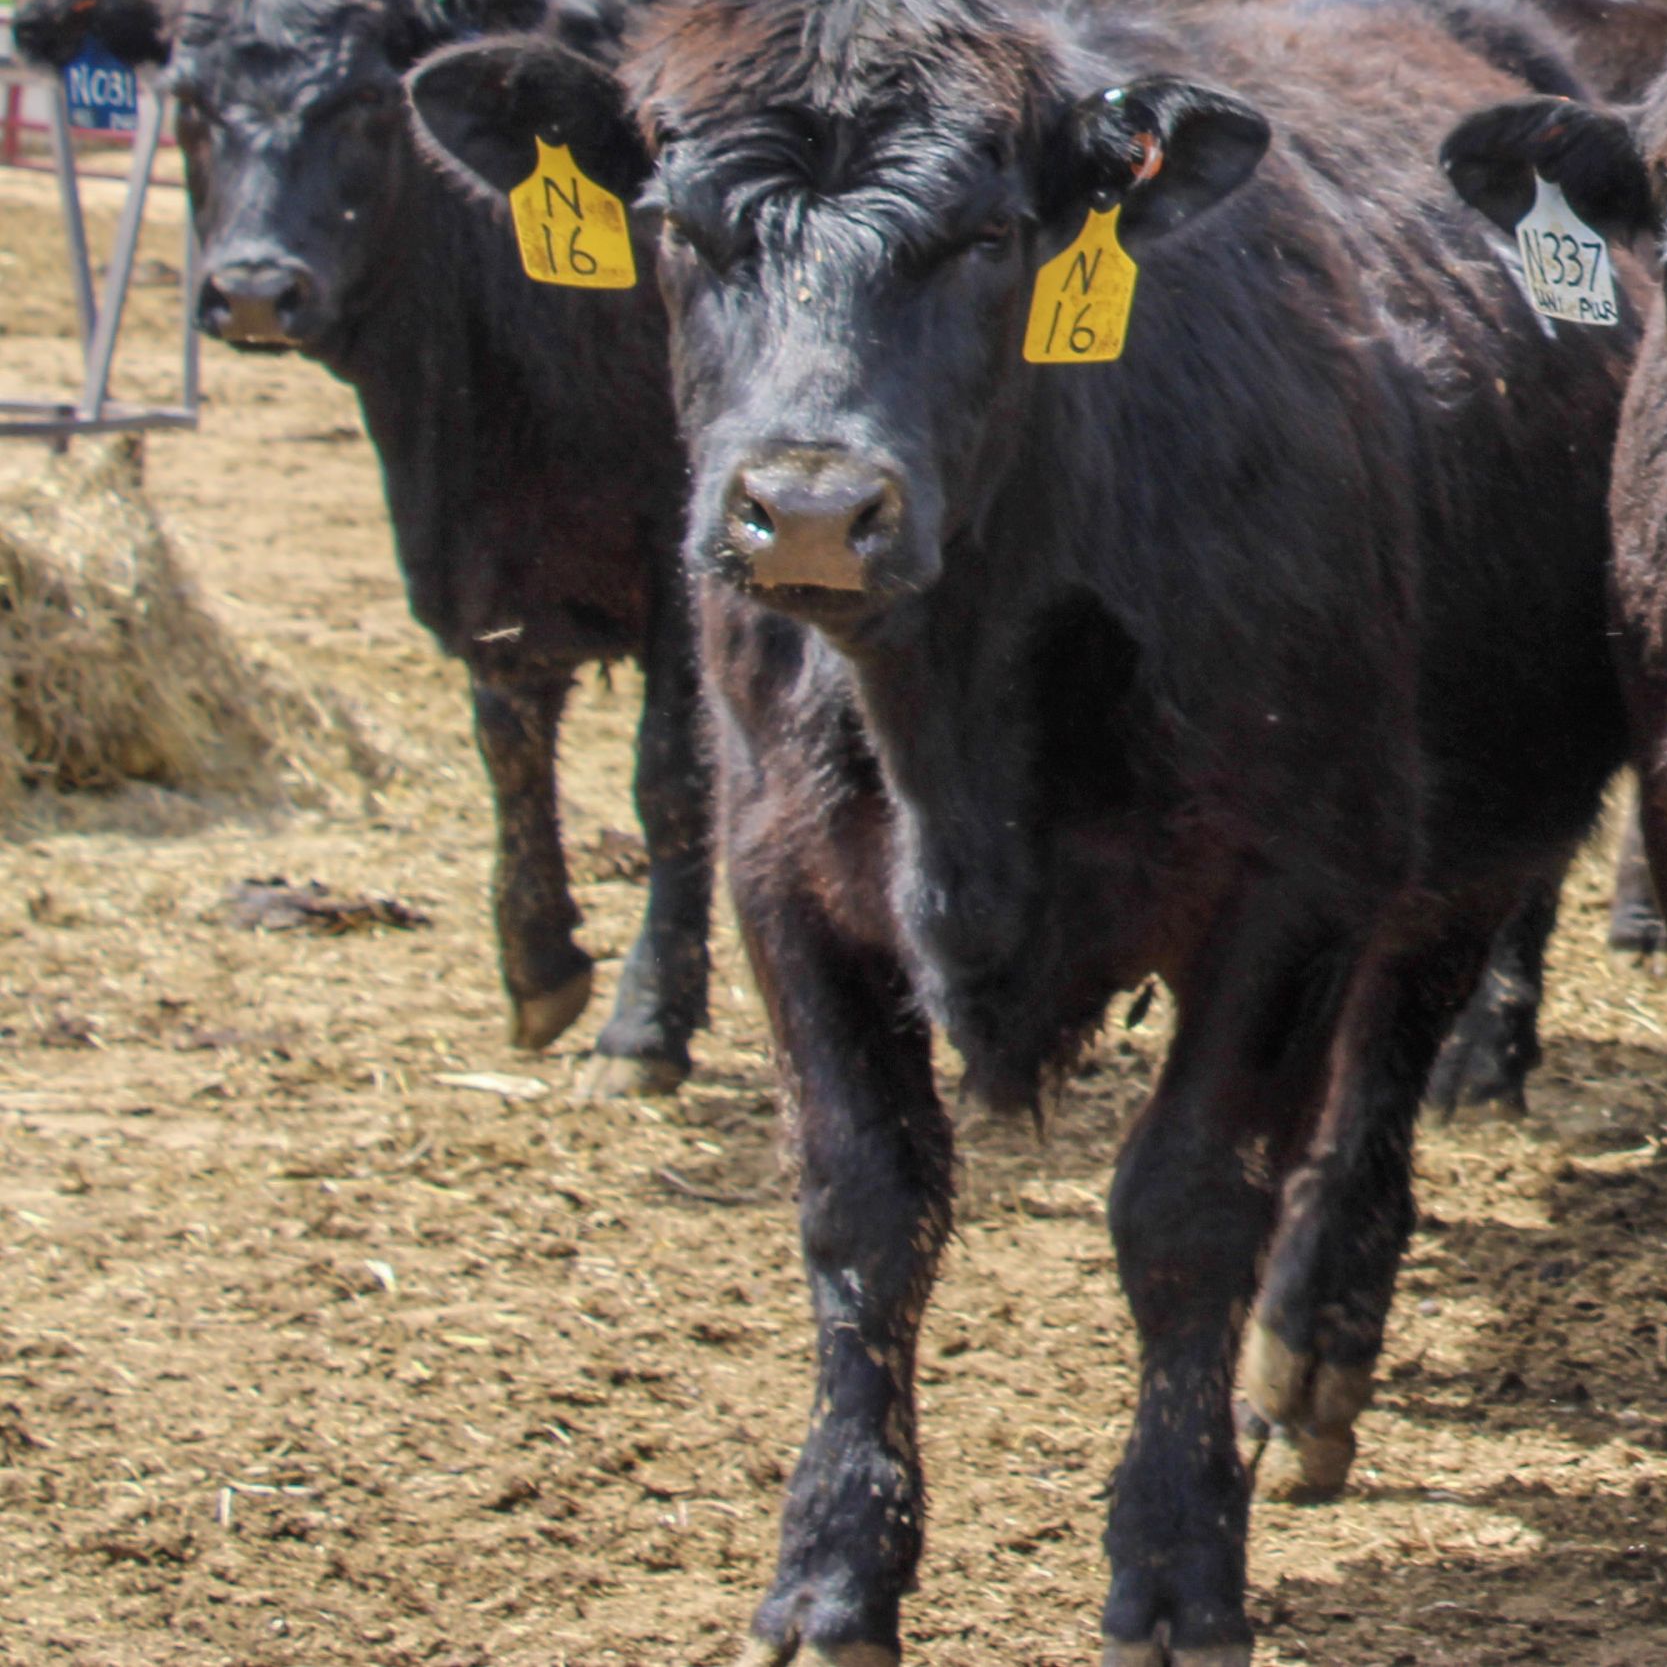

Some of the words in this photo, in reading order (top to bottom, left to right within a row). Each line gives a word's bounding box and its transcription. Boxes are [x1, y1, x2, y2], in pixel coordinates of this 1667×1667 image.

[543, 176, 584, 221] N
[541, 223, 598, 275] 16
[1061, 247, 1103, 296] N
[1522, 229, 1603, 292] N337
[1045, 299, 1096, 354] 16
